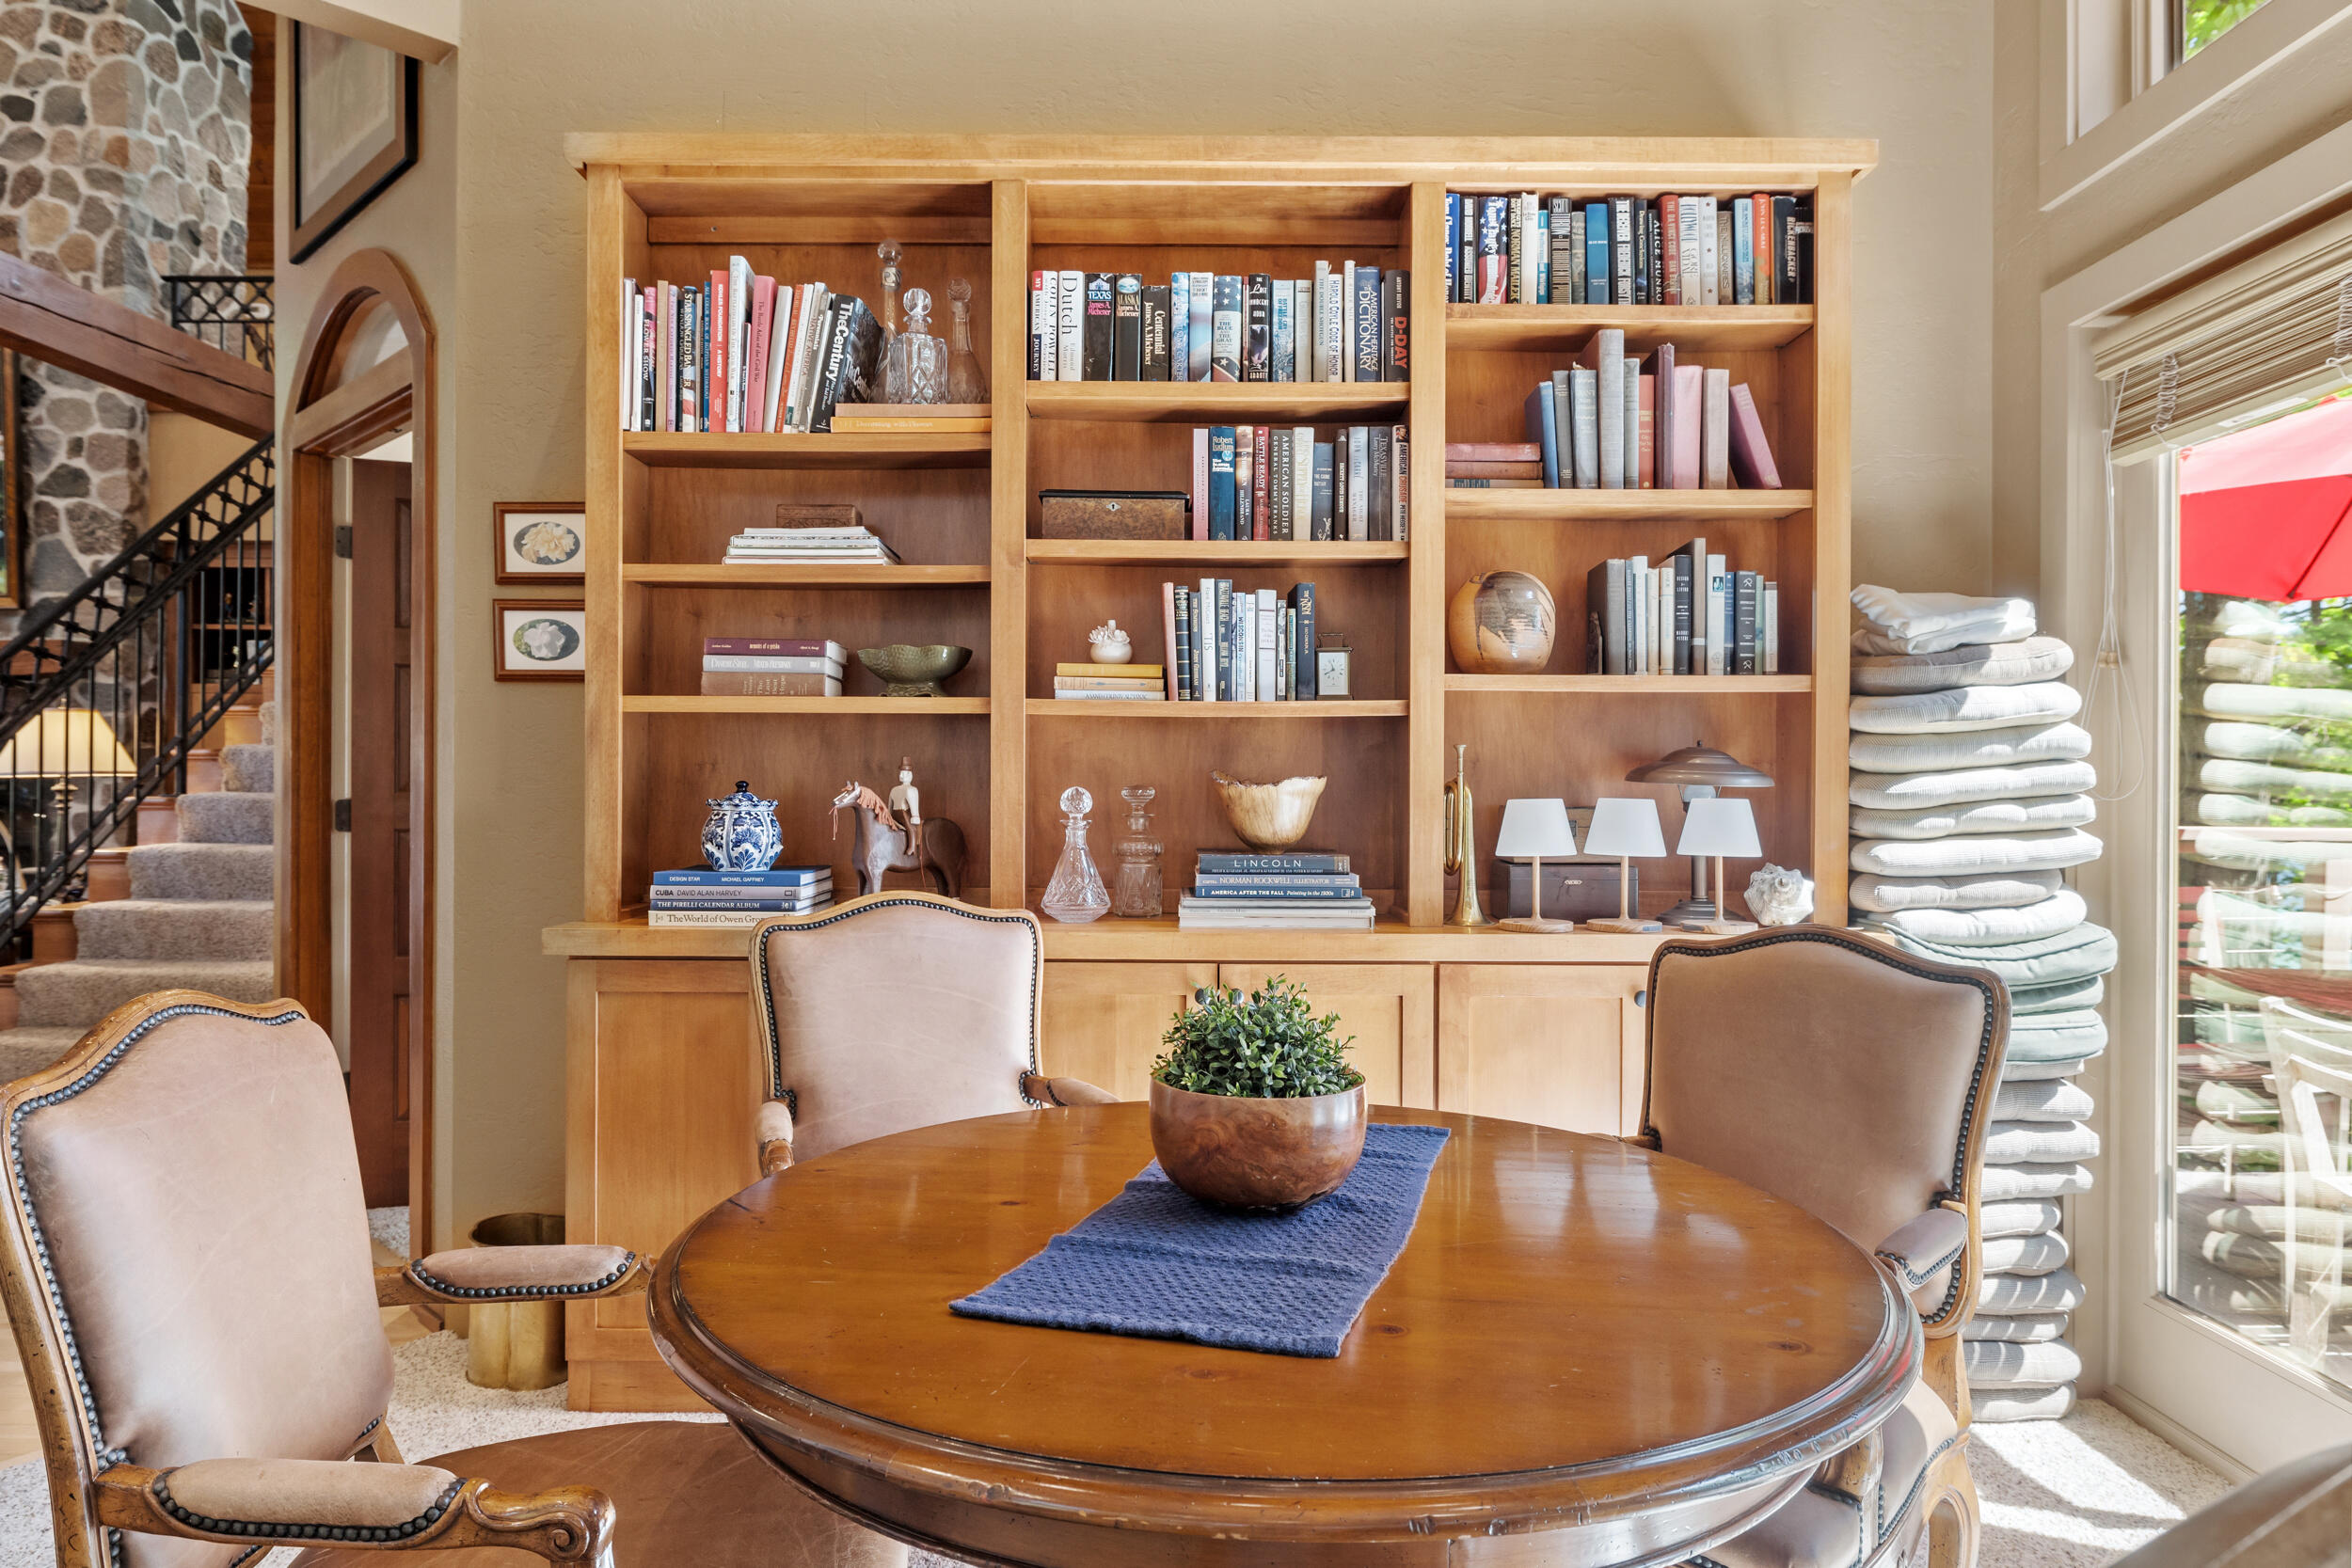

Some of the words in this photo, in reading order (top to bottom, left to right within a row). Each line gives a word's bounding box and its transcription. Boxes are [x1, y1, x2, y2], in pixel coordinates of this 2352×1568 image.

[1616, 200, 1629, 212] THE
[1667, 214, 1675, 222] DA
[1511, 229, 1521, 264] NORMAN
[1787, 217, 1796, 277] RICKENBACKER
[1035, 278, 1041, 288] MY
[1088, 291, 1112, 299] TEXAS
[1329, 280, 1339, 304] HAROLD
[1511, 266, 1521, 300] MAILER
[684, 293, 693, 312] STAR
[1062, 277, 1077, 336] Dutch
[1144, 301, 1153, 324] James
[1329, 306, 1339, 325] COYLE
[684, 314, 693, 354] SPANGLED
[807, 317, 818, 344] NATIVE
[813, 315, 823, 350] Perennials
[1144, 324, 1153, 333] A.
[1155, 310, 1165, 354] Centennial
[1329, 327, 1339, 343] CODE
[1359, 291, 1370, 370] DICTIONARY
[1395, 316, 1407, 369] D-DAY
[802, 345, 812, 376] AMERICA
[1048, 325, 1056, 375] POWELL
[1144, 333, 1153, 365] Michener
[684, 355, 692, 387] BANER
[1329, 354, 1339, 376] HONOR
[1380, 436, 1388, 477] TEXASVILLE
[667, 914, 684, 923] The
[684, 915, 708, 923] World
[710, 914, 718, 923] of
